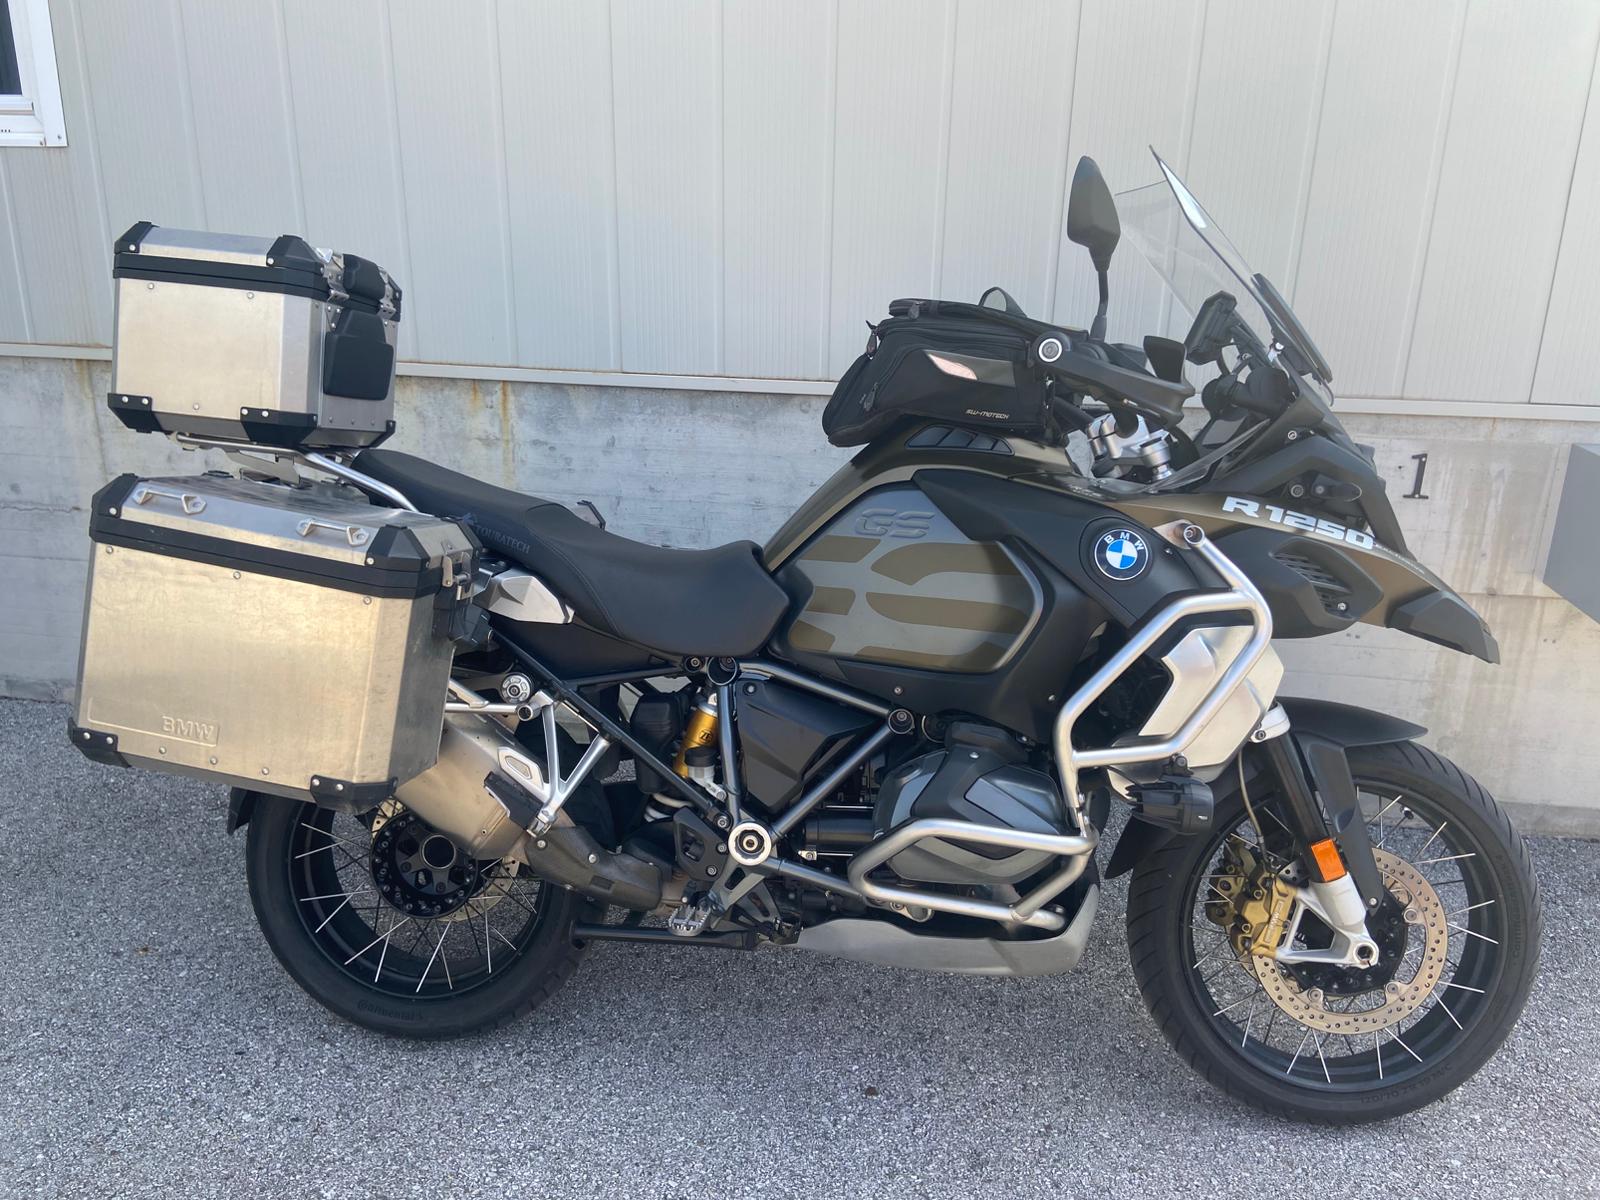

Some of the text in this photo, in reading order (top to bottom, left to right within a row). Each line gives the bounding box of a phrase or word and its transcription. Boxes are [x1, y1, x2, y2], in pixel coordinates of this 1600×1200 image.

[1402, 453, 1429, 499] 1
[854, 507, 936, 539] GS
[1222, 496, 1376, 550] R 1250
[475, 525, 531, 554] TOURATECH
[1103, 531, 1145, 551] BMW
[162, 715, 215, 740] BMW
